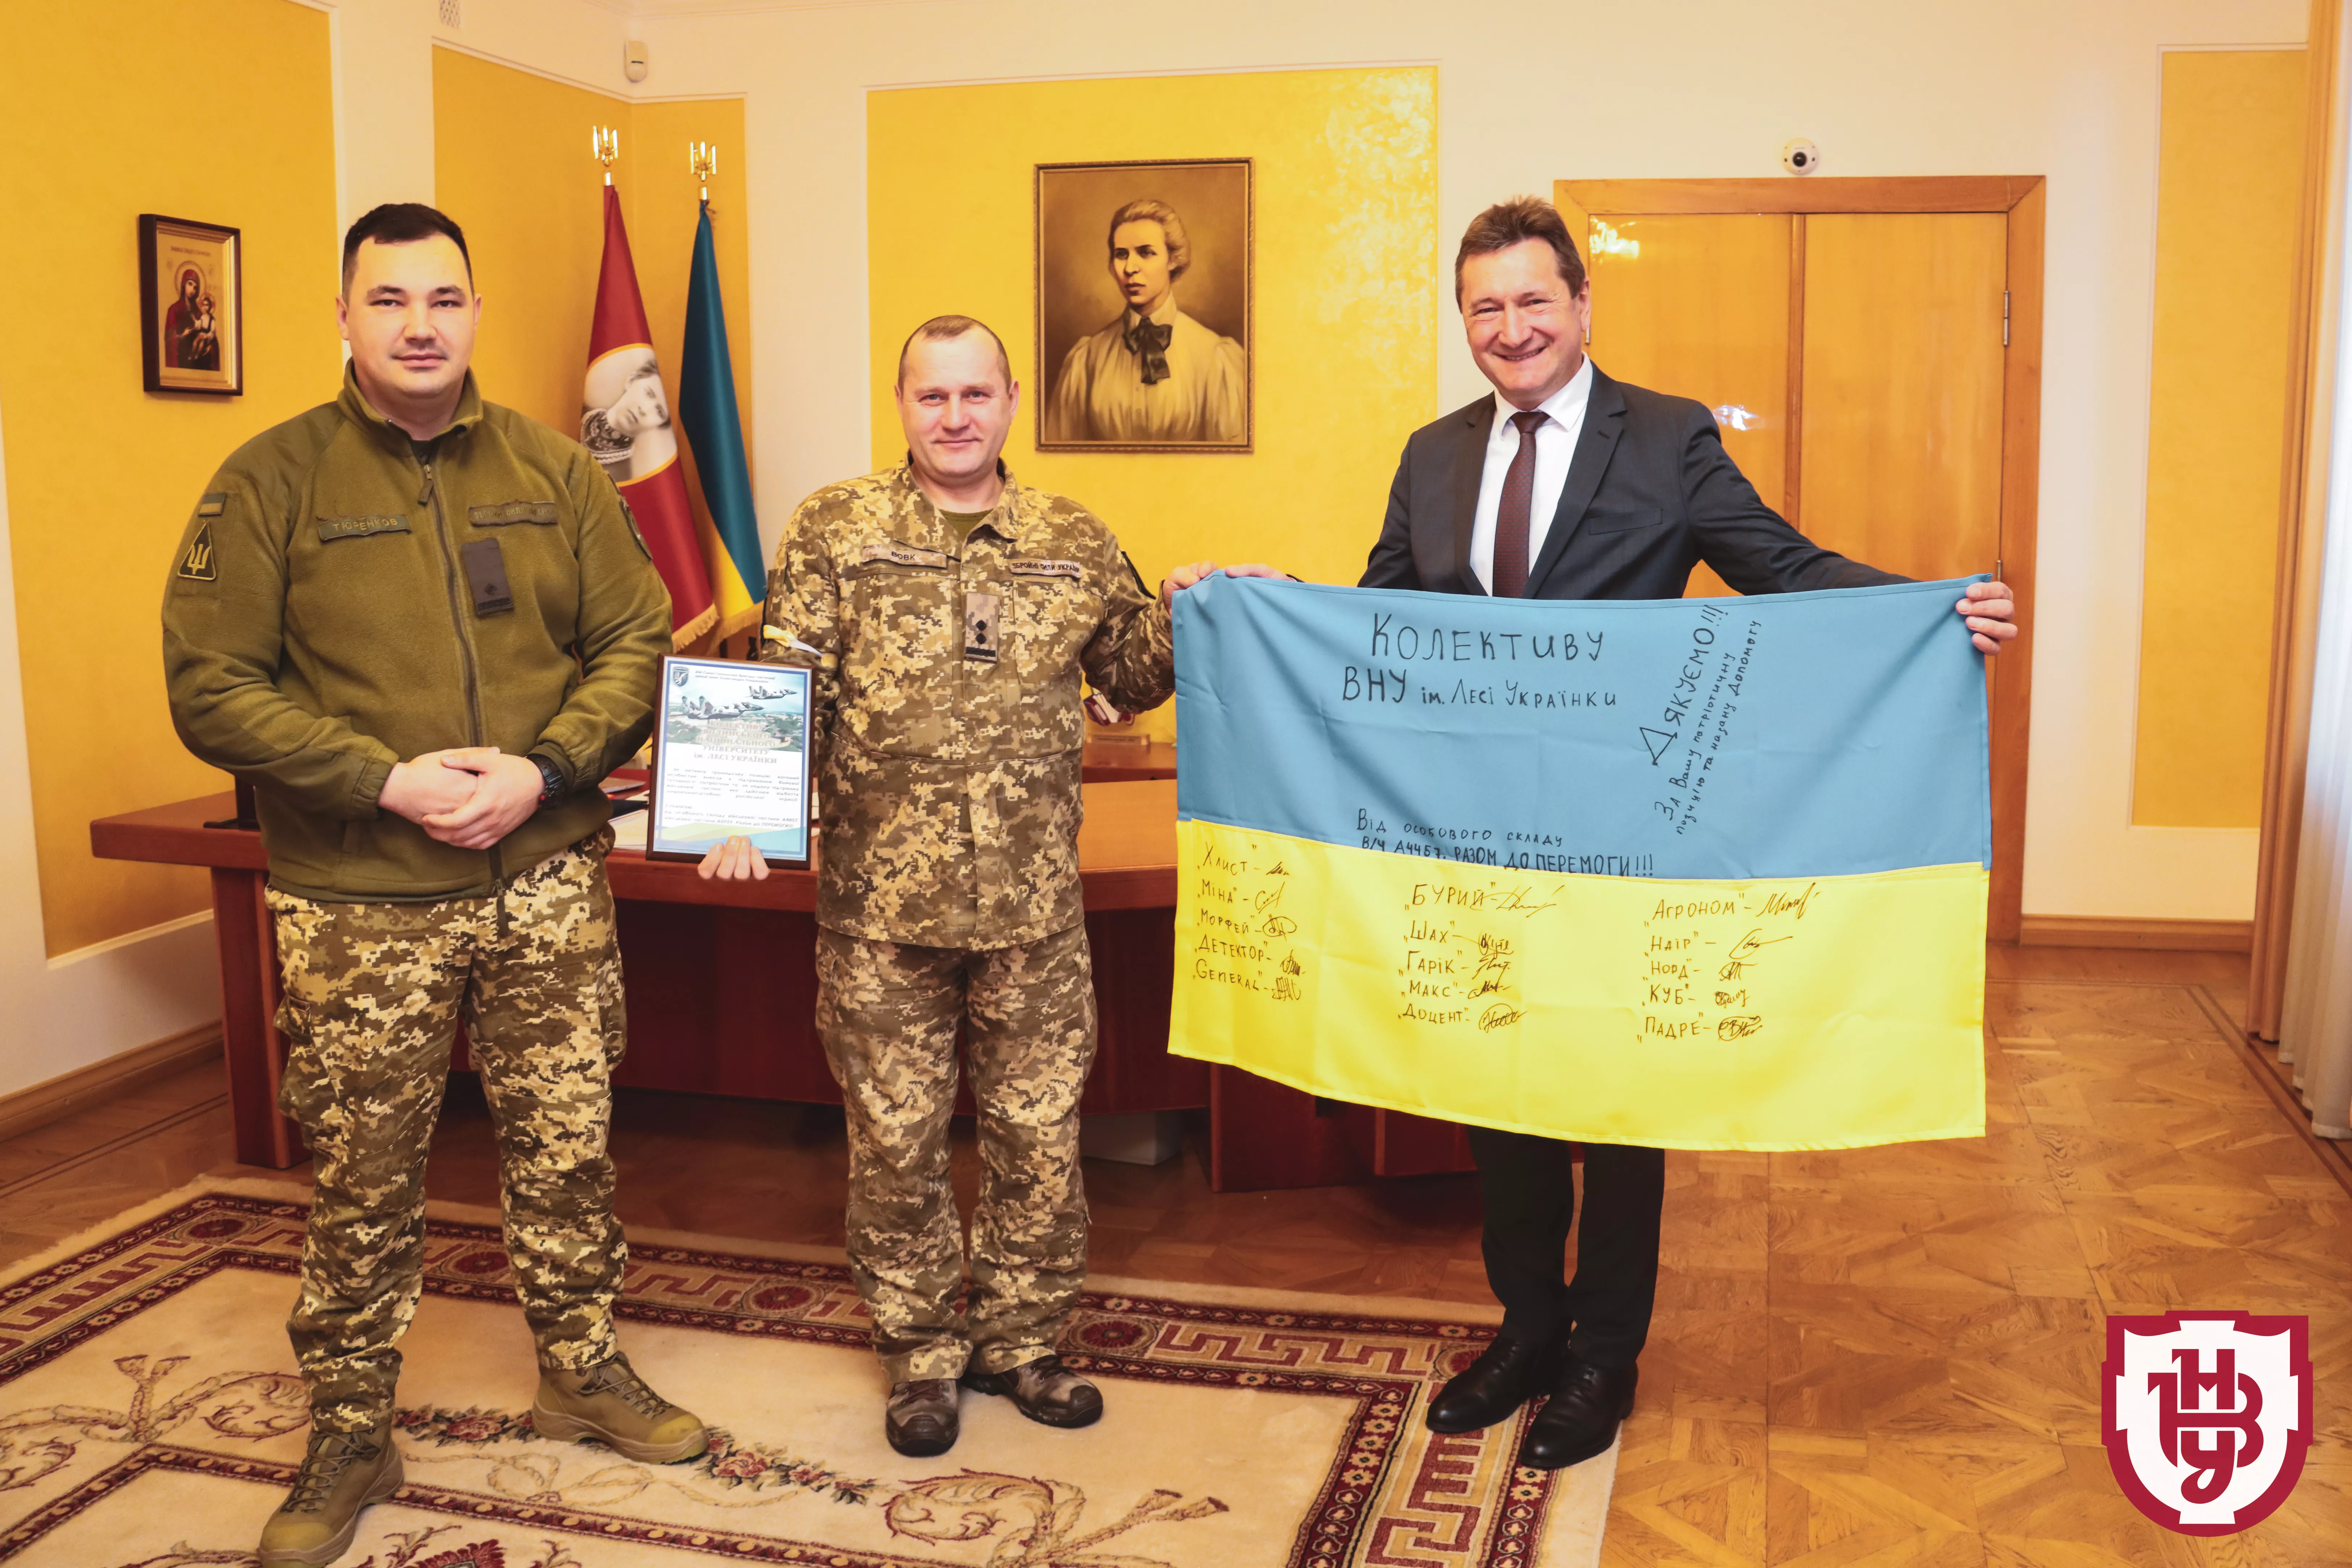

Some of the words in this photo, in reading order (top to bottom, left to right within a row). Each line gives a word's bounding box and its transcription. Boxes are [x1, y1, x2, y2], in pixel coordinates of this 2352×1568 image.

[332, 518, 398, 531] ТЮРЕНКОВ
[891, 551, 916, 560] ВОВК
[1343, 666, 1406, 703] ВНУ
[1422, 687, 1445, 705] ім.
[711, 721, 763, 730] КОЛЕКТИВУ
[703, 729, 771, 739] ВОЛИНСЬКОГО
[1703, 755, 1714, 771] та
[1711, 703, 1736, 750] надану
[697, 736, 776, 747] НАЦІОНАЛЬНОГО
[703, 745, 770, 755] УНІВЕРСИТЕТУ
[731, 755, 777, 764] УКРАЇНКИ
[1669, 749, 1702, 789] Вашу
[1454, 847, 1497, 866] РАЗОМ
[1504, 852, 1529, 871] ДО
[1536, 854, 1654, 877] ПЕРЕМОГИ!!!
